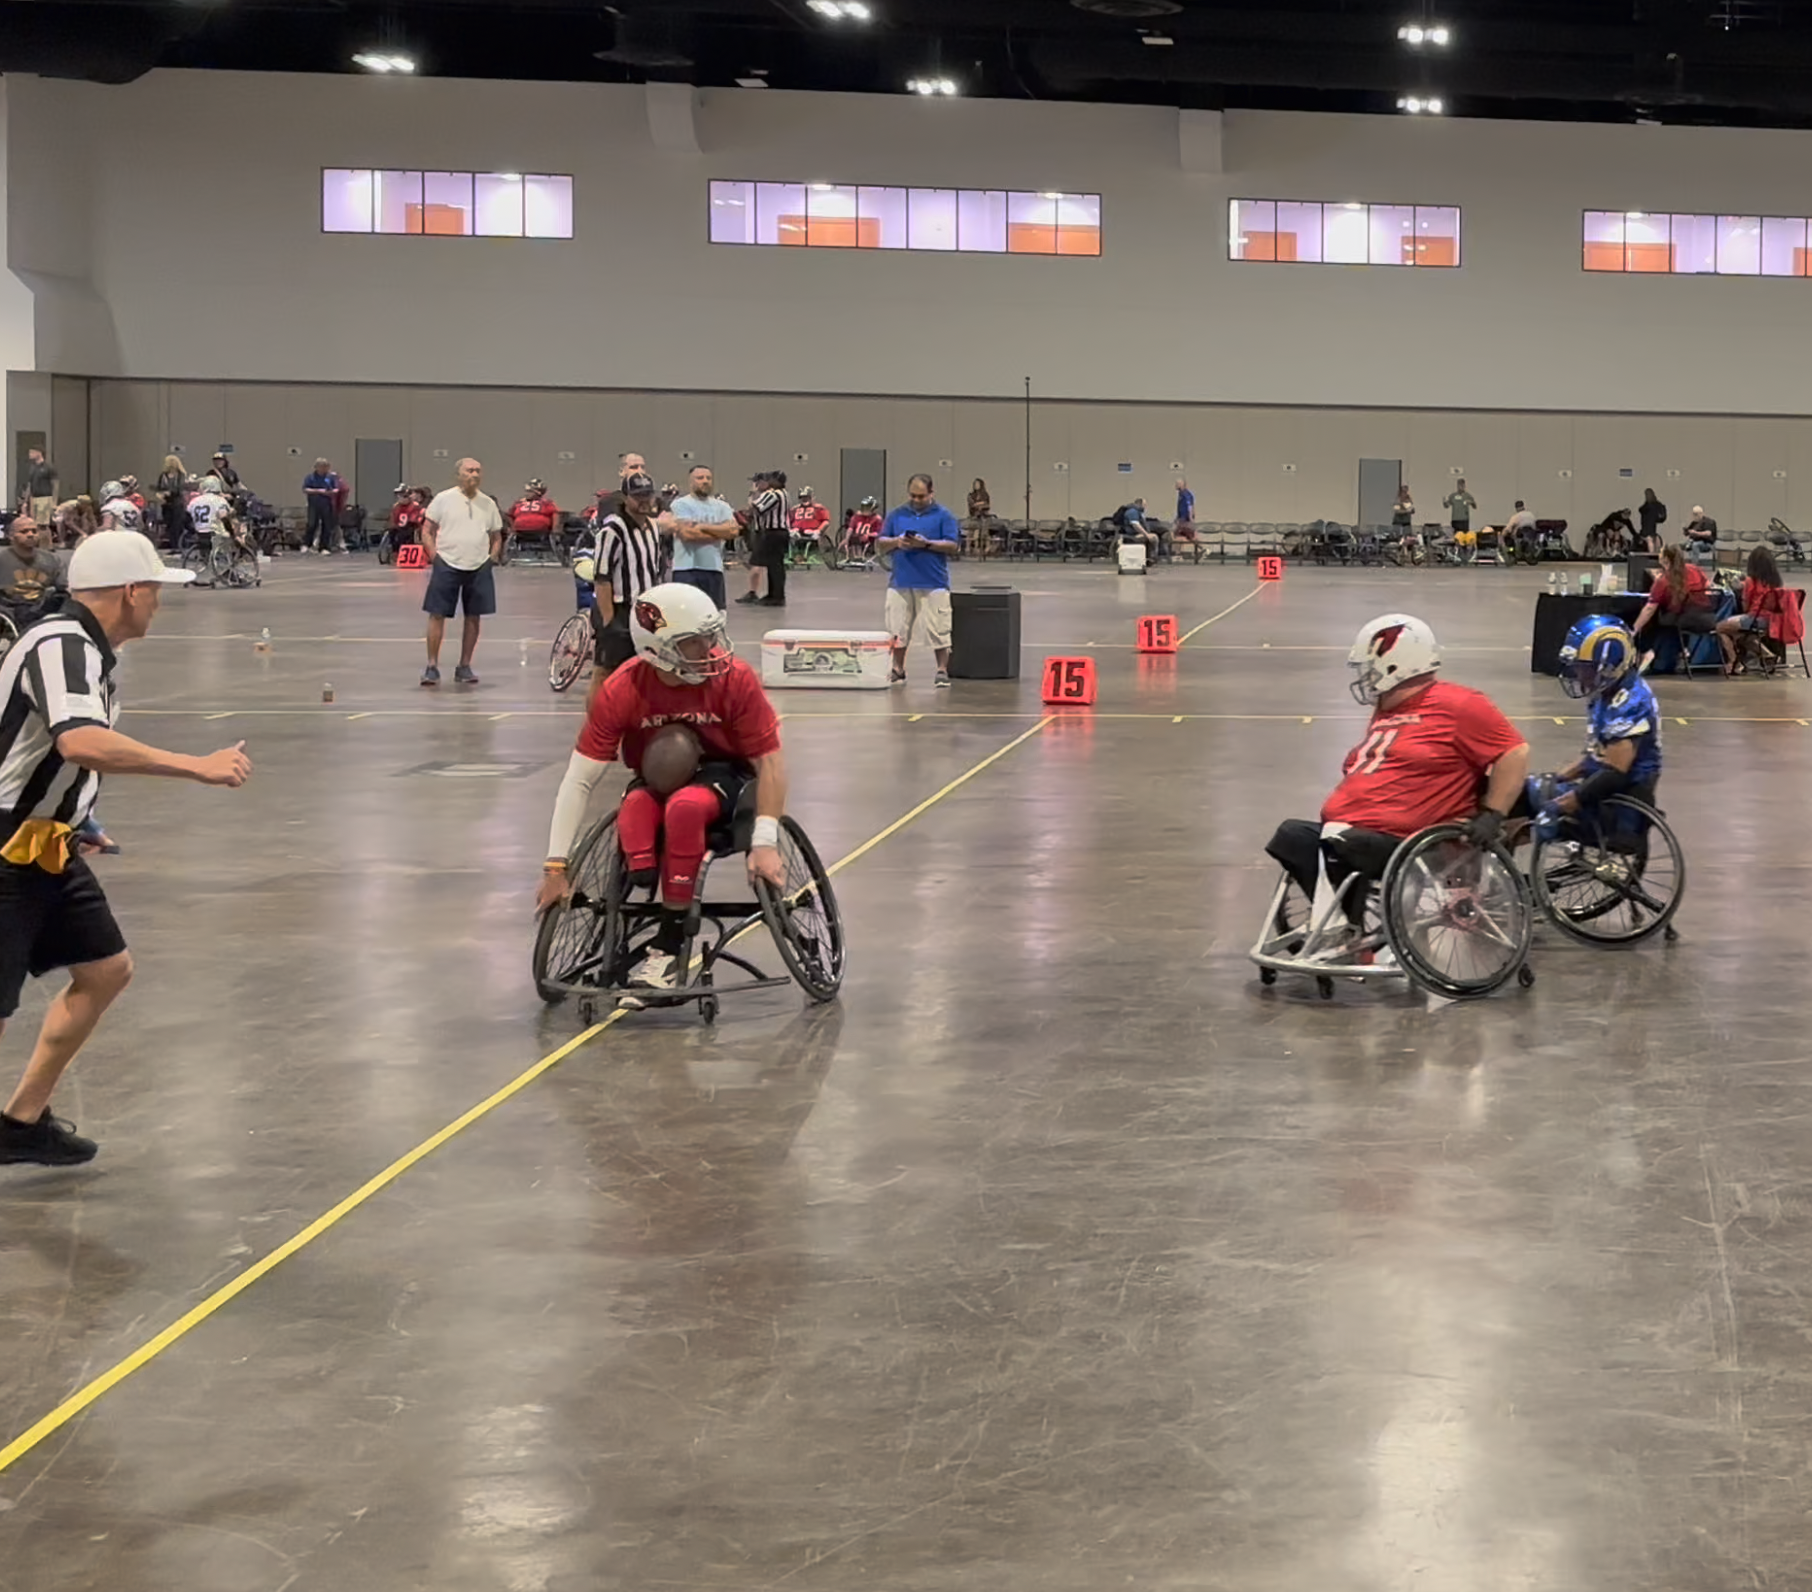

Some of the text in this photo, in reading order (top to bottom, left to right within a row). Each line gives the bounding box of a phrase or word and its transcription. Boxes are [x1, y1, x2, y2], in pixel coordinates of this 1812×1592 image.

[399, 513, 408, 527] 9
[795, 507, 815, 519] 22
[400, 547, 419, 564] 30
[1262, 560, 1277, 575] 15
[1144, 619, 1170, 647] 15
[1050, 661, 1085, 697] 15
